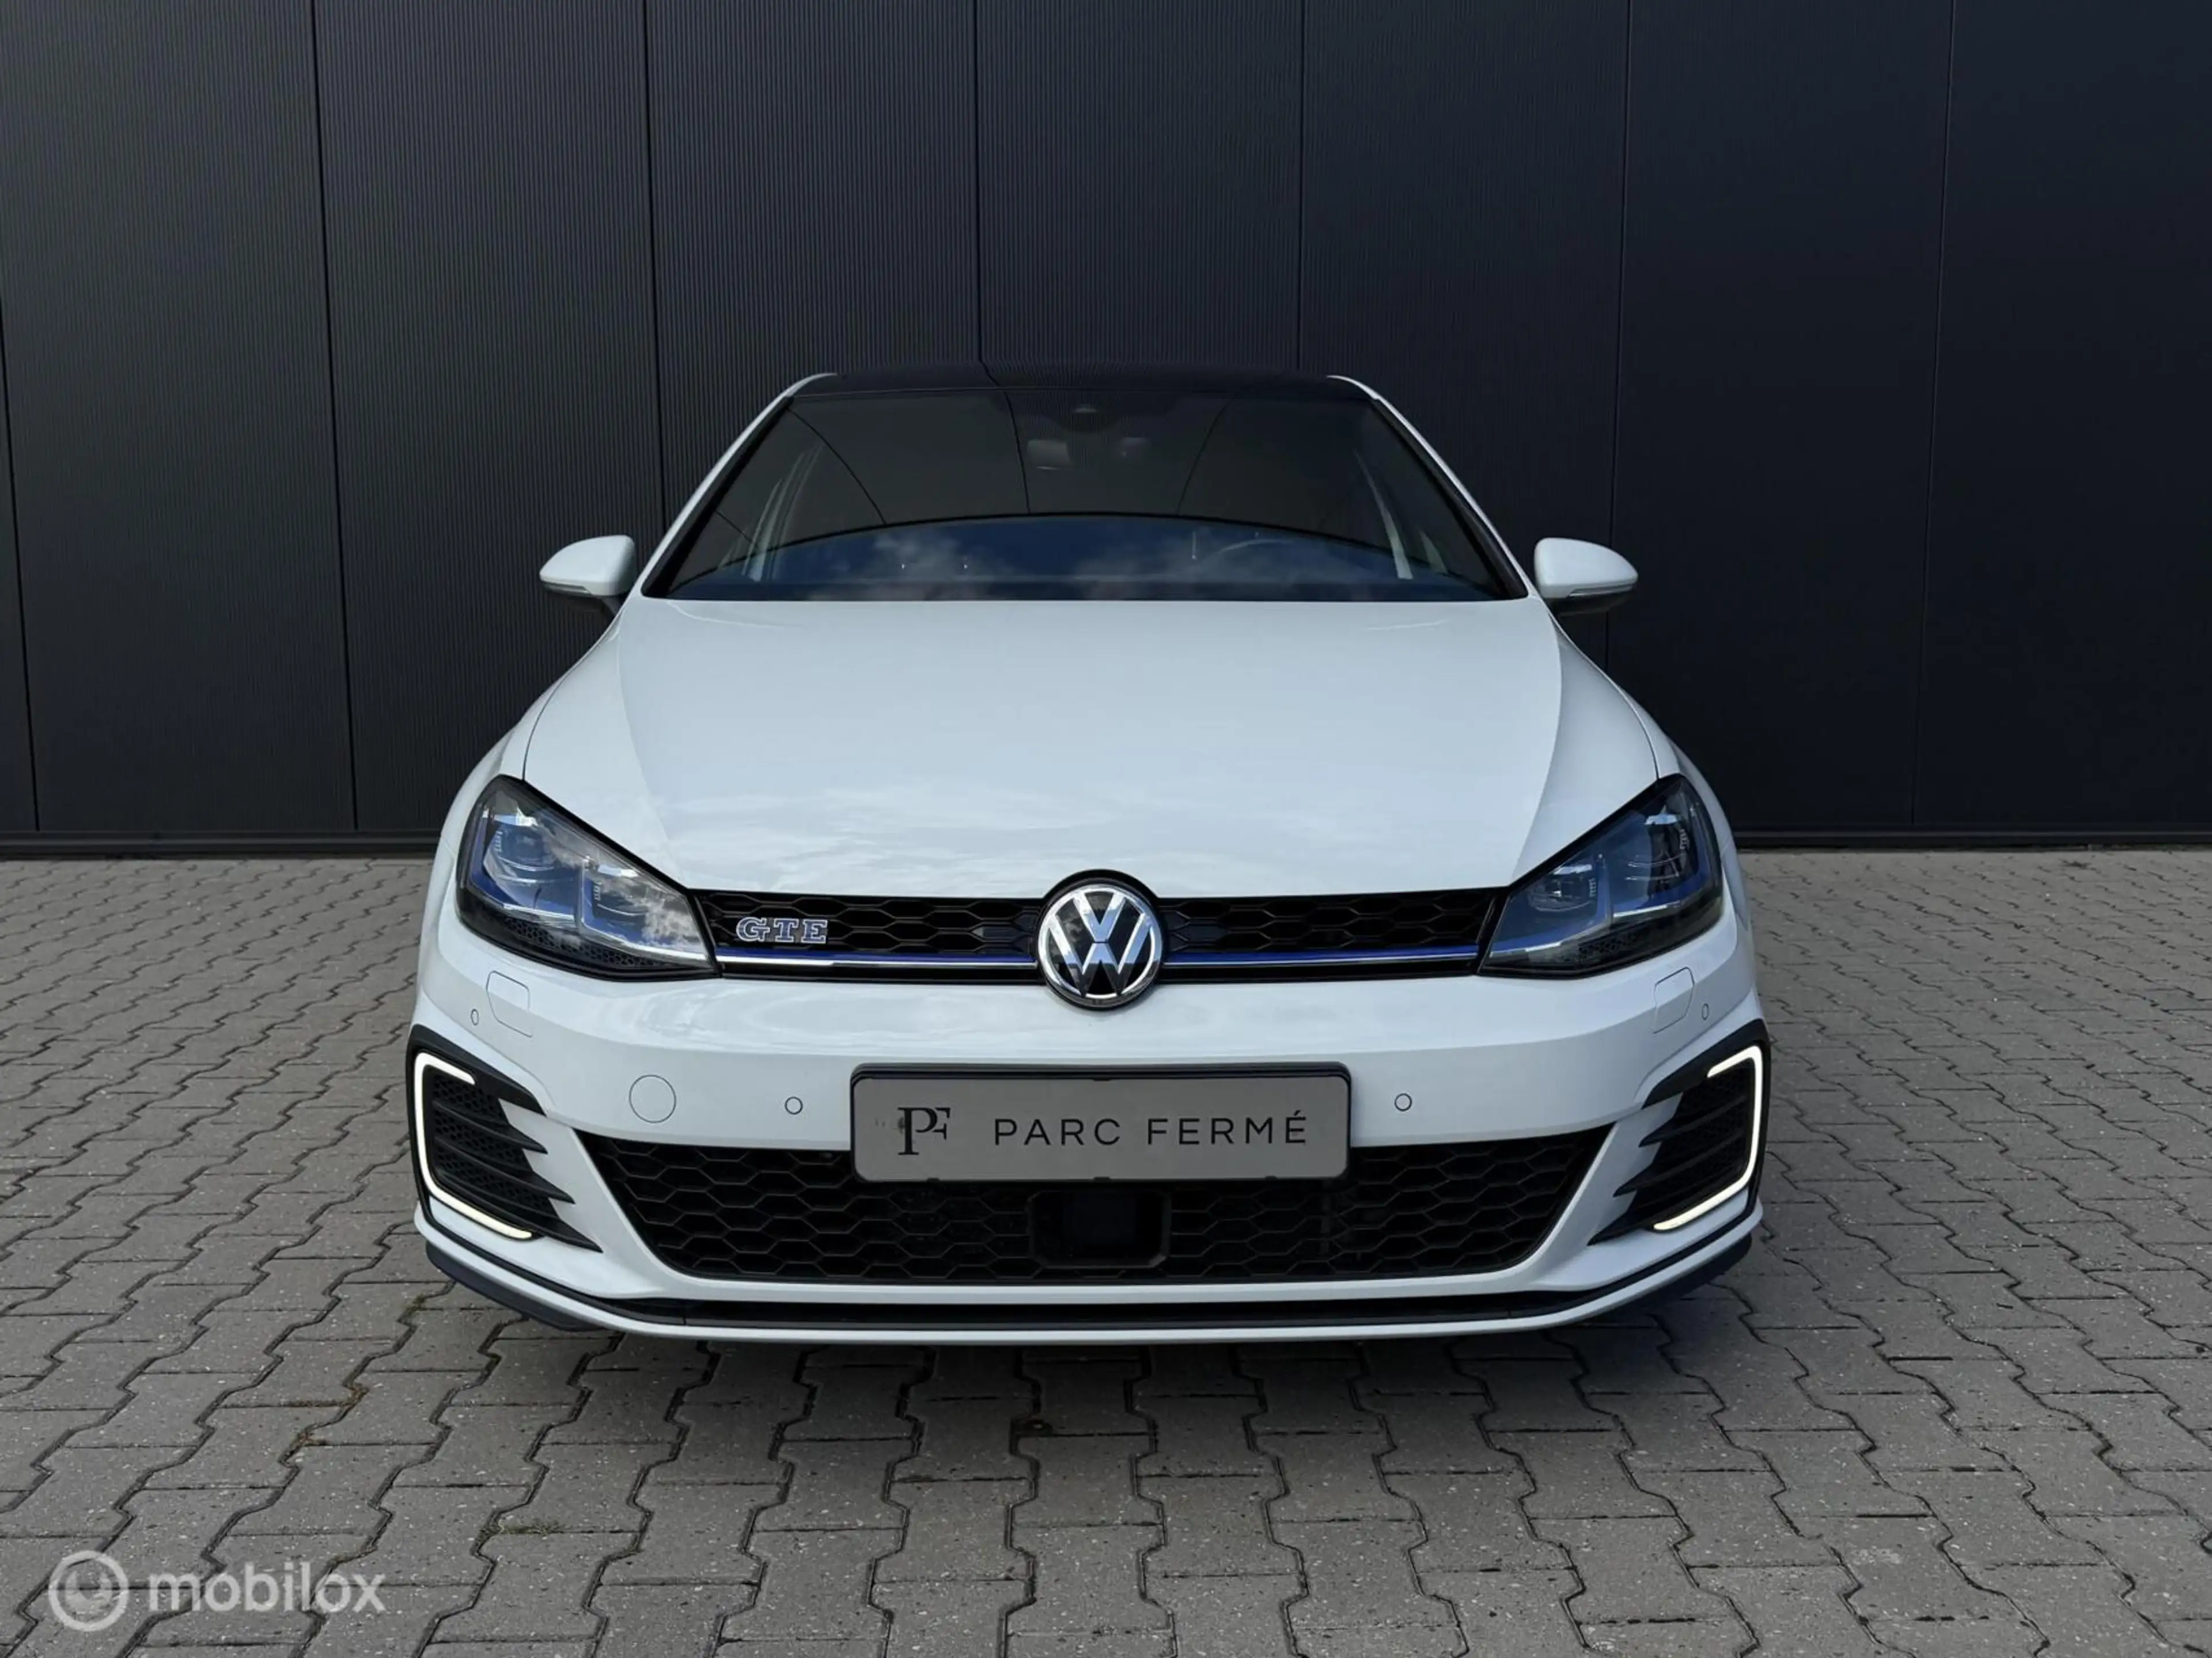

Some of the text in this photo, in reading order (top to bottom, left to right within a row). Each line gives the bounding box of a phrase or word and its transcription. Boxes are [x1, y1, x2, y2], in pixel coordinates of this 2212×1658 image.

[736, 916, 828, 944] GTE
[994, 1118, 1122, 1146] PARC
[1147, 1110, 1308, 1145] FERMÉ
